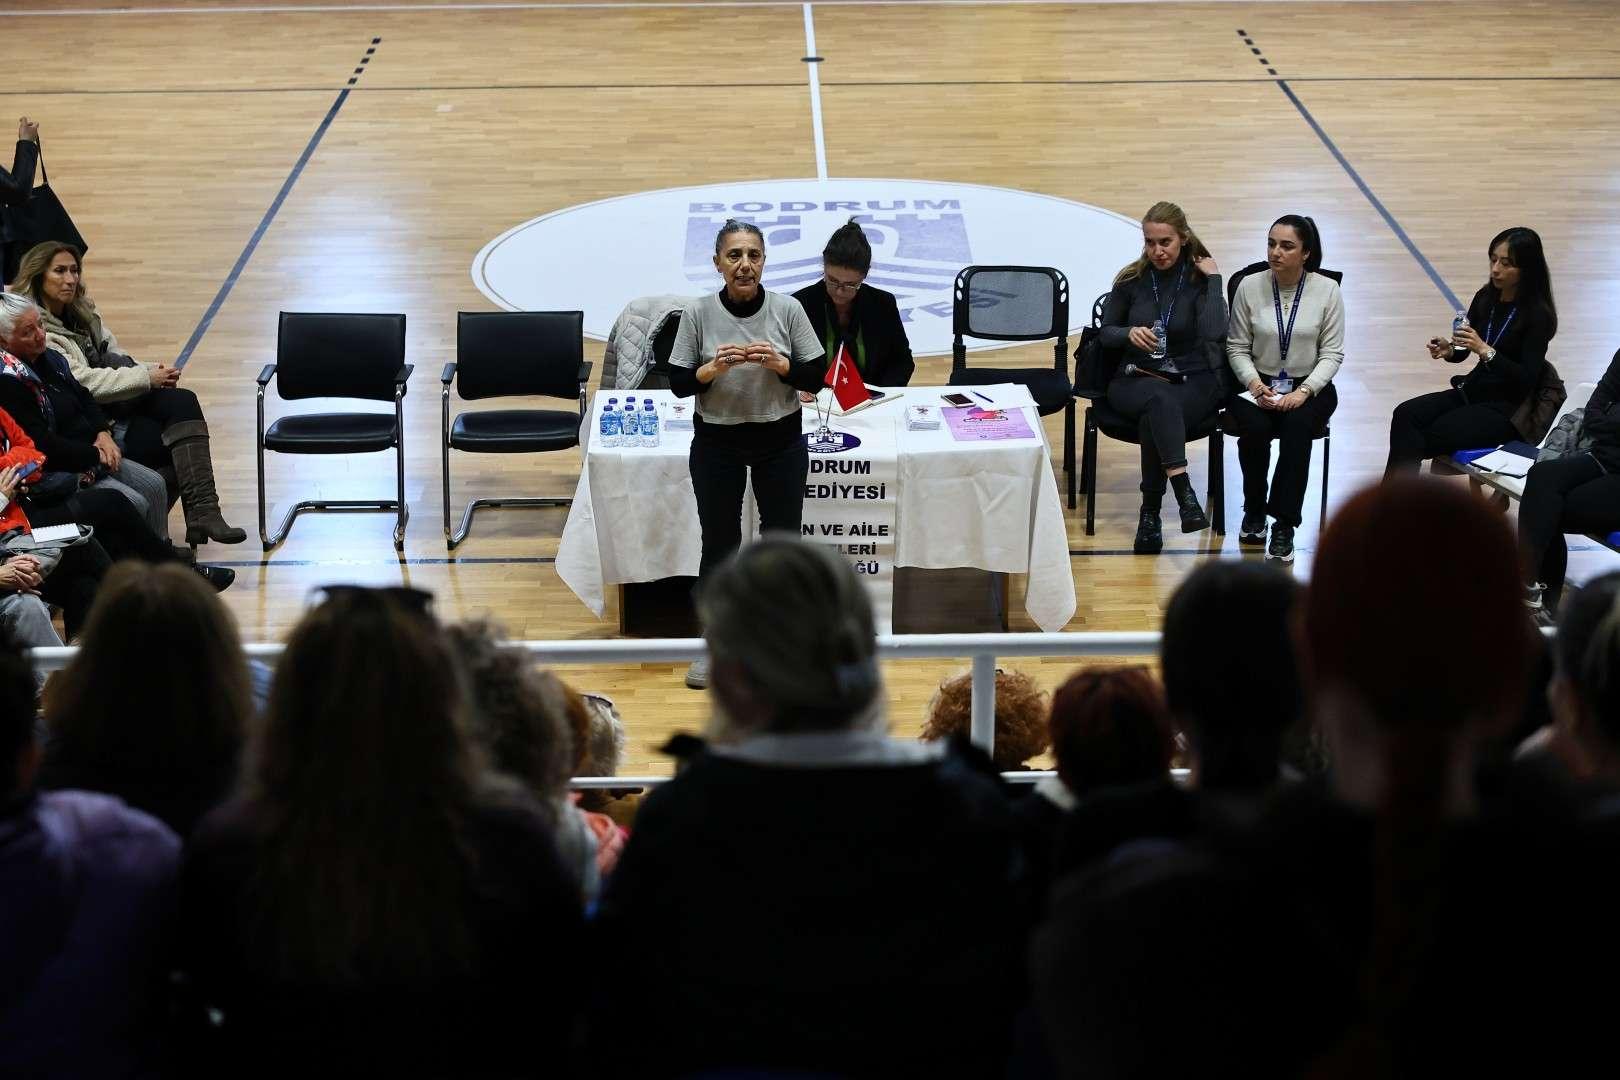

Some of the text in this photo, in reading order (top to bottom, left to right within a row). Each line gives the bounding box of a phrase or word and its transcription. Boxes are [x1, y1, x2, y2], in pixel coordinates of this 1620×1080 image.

[688, 199, 961, 214] BODRUM
[810, 459, 871, 474] DRUM
[804, 481, 886, 499] EDİYESİ
[820, 524, 843, 536] VE
[848, 521, 889, 536] AİLE
